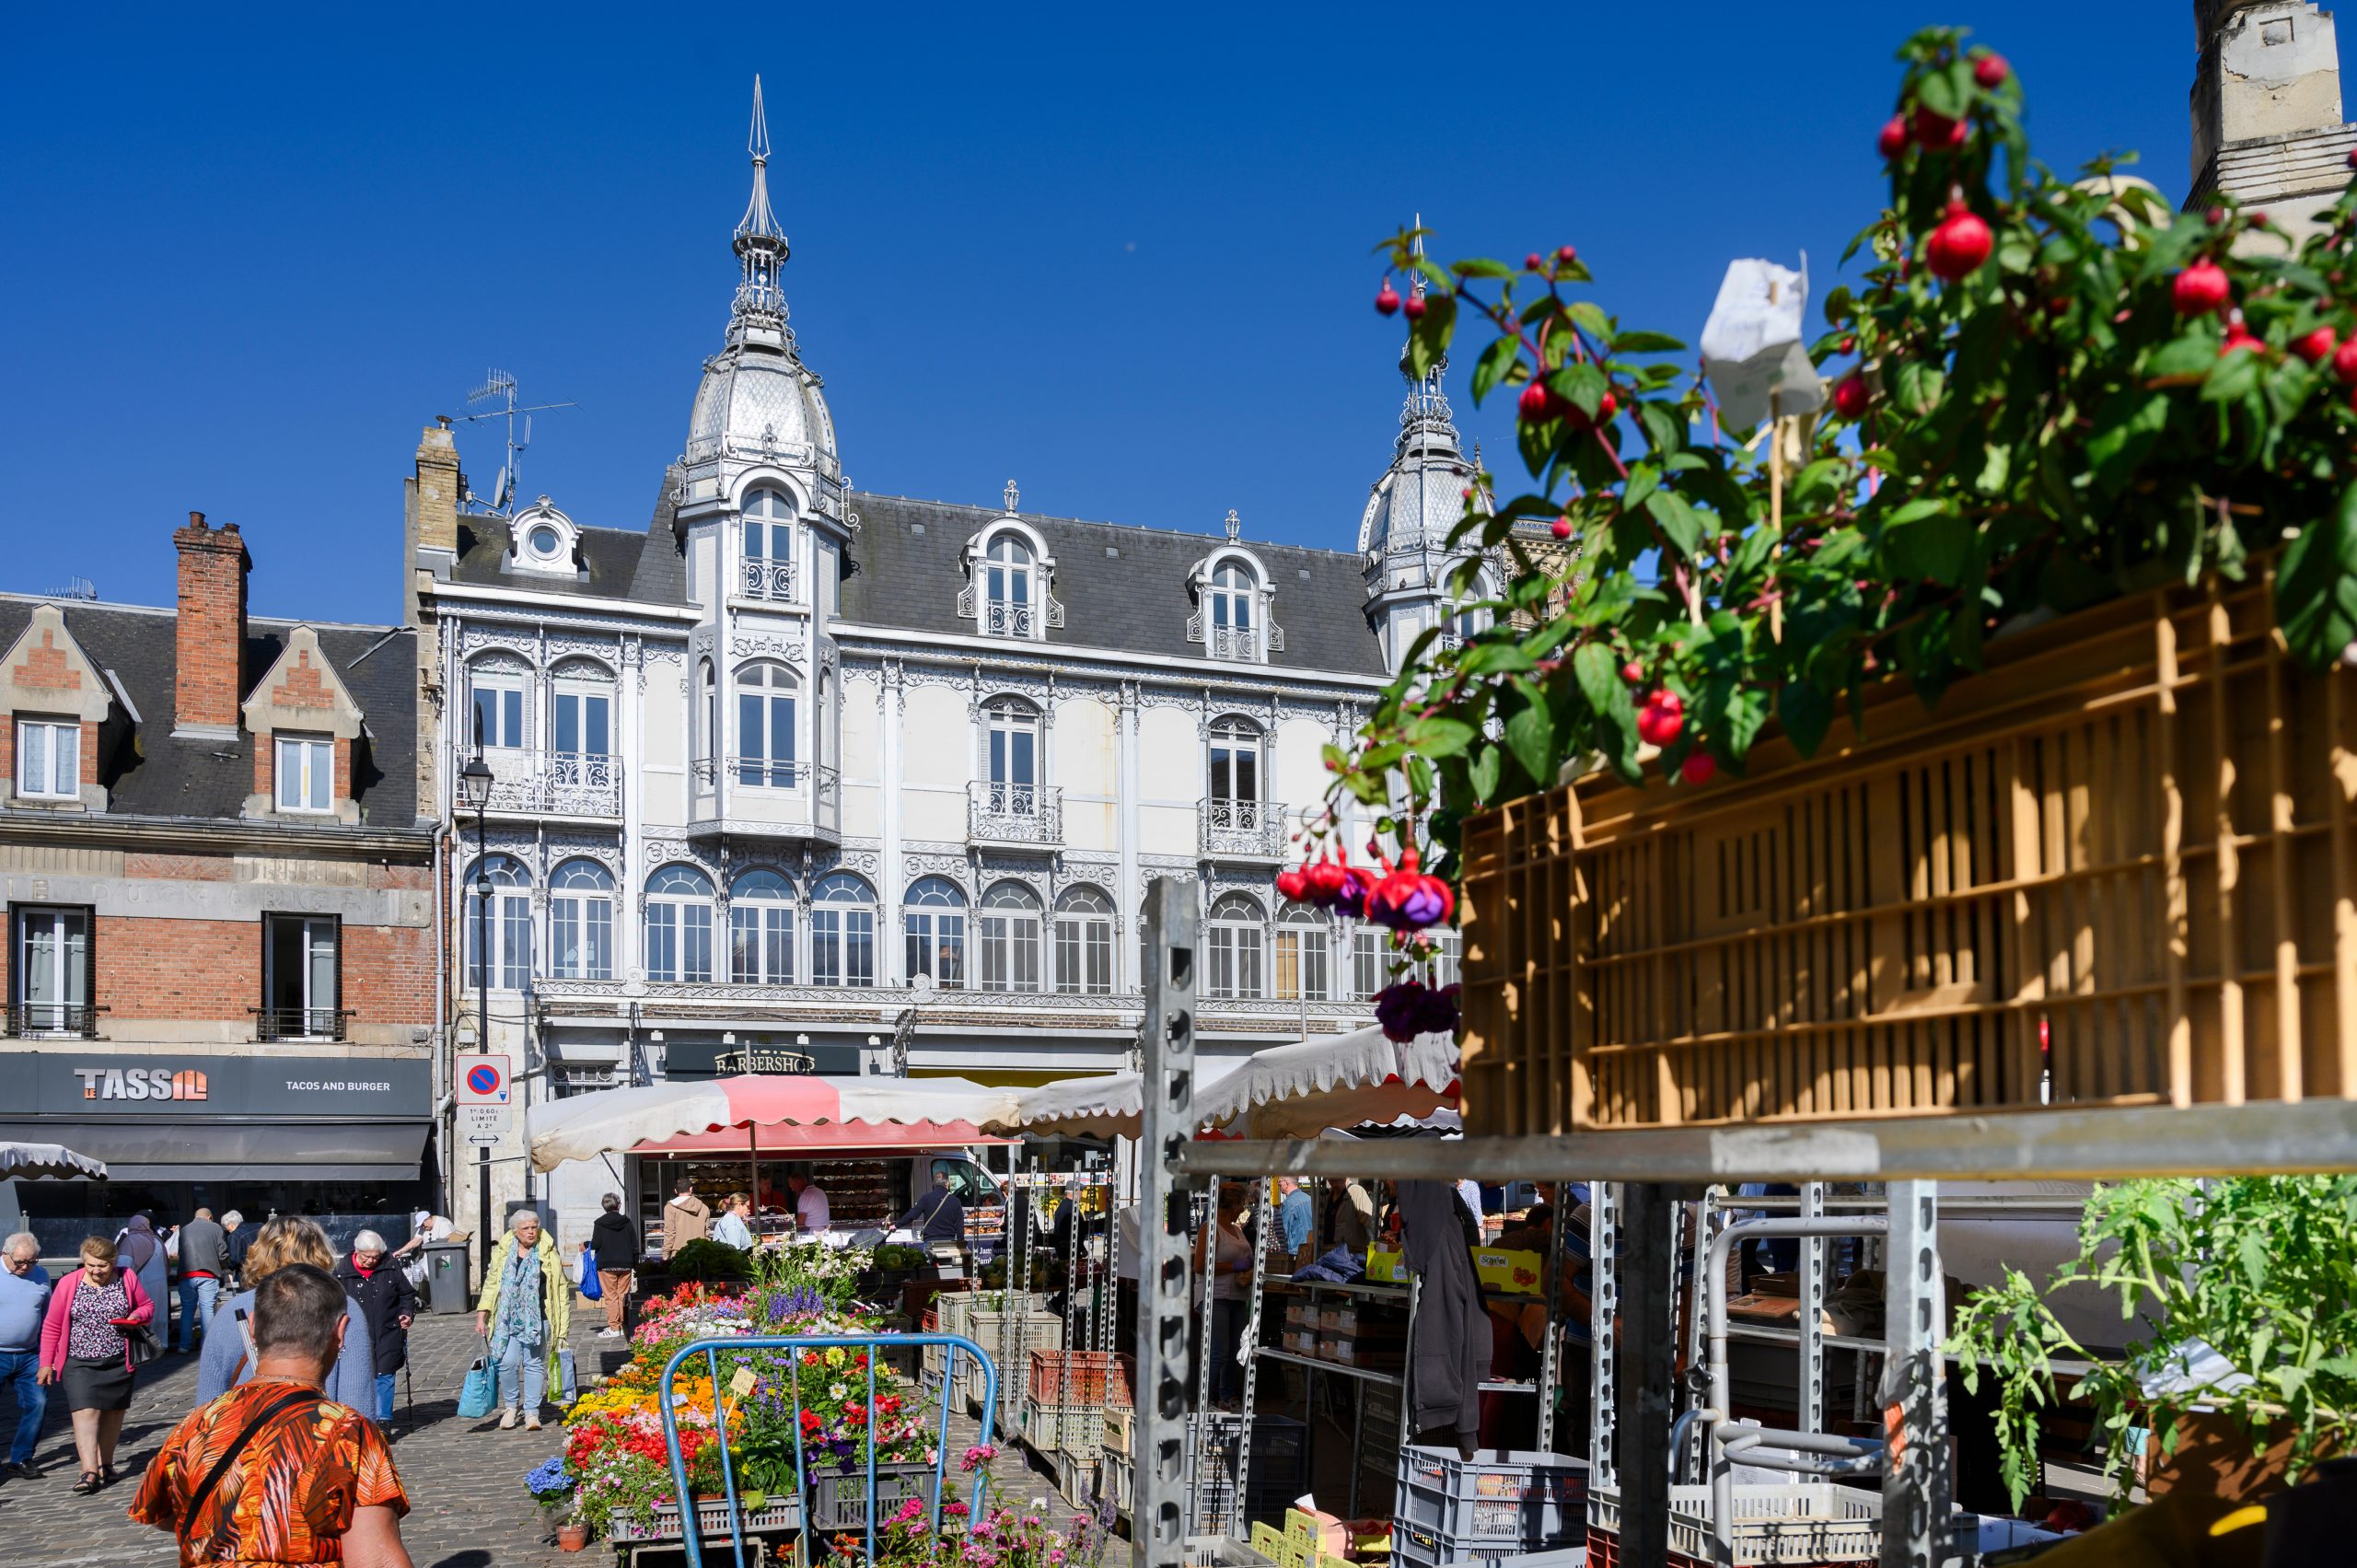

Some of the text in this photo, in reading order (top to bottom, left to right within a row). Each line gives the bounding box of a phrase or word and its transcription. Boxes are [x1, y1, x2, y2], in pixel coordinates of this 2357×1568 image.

[75, 1068, 207, 1100] TASSIL
[285, 1081, 390, 1091] TACOS AND BURGER
